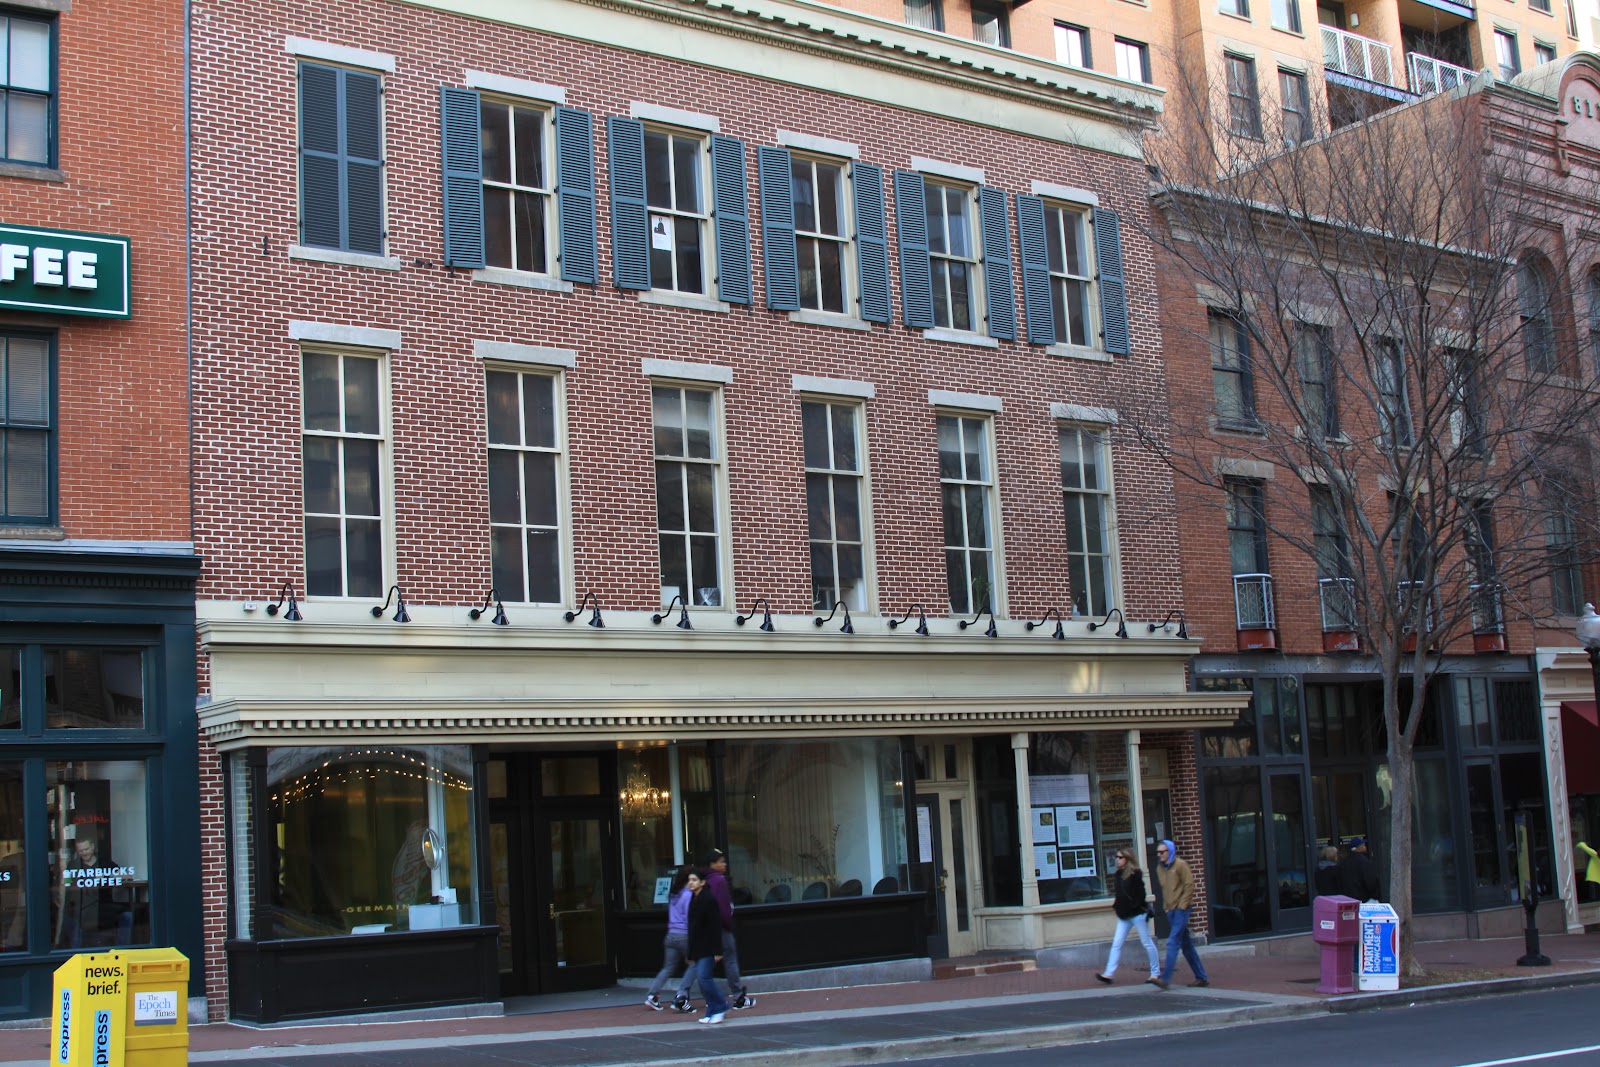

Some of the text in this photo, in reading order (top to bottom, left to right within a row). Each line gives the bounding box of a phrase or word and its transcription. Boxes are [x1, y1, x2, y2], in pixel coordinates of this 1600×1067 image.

[1572, 95, 1600, 121] 81
[0, 243, 98, 290] FEE
[63, 866, 135, 878] STARBUCKS
[76, 877, 123, 888] COFFEE
[1364, 923, 1374, 972] APARTMENT
[85, 966, 124, 978] news.
[87, 980, 121, 996] brief.
[138, 998, 171, 1012] Epoch
[154, 1009, 176, 1018] Times
[61, 991, 70, 1060] express
[96, 1012, 108, 1067] press
